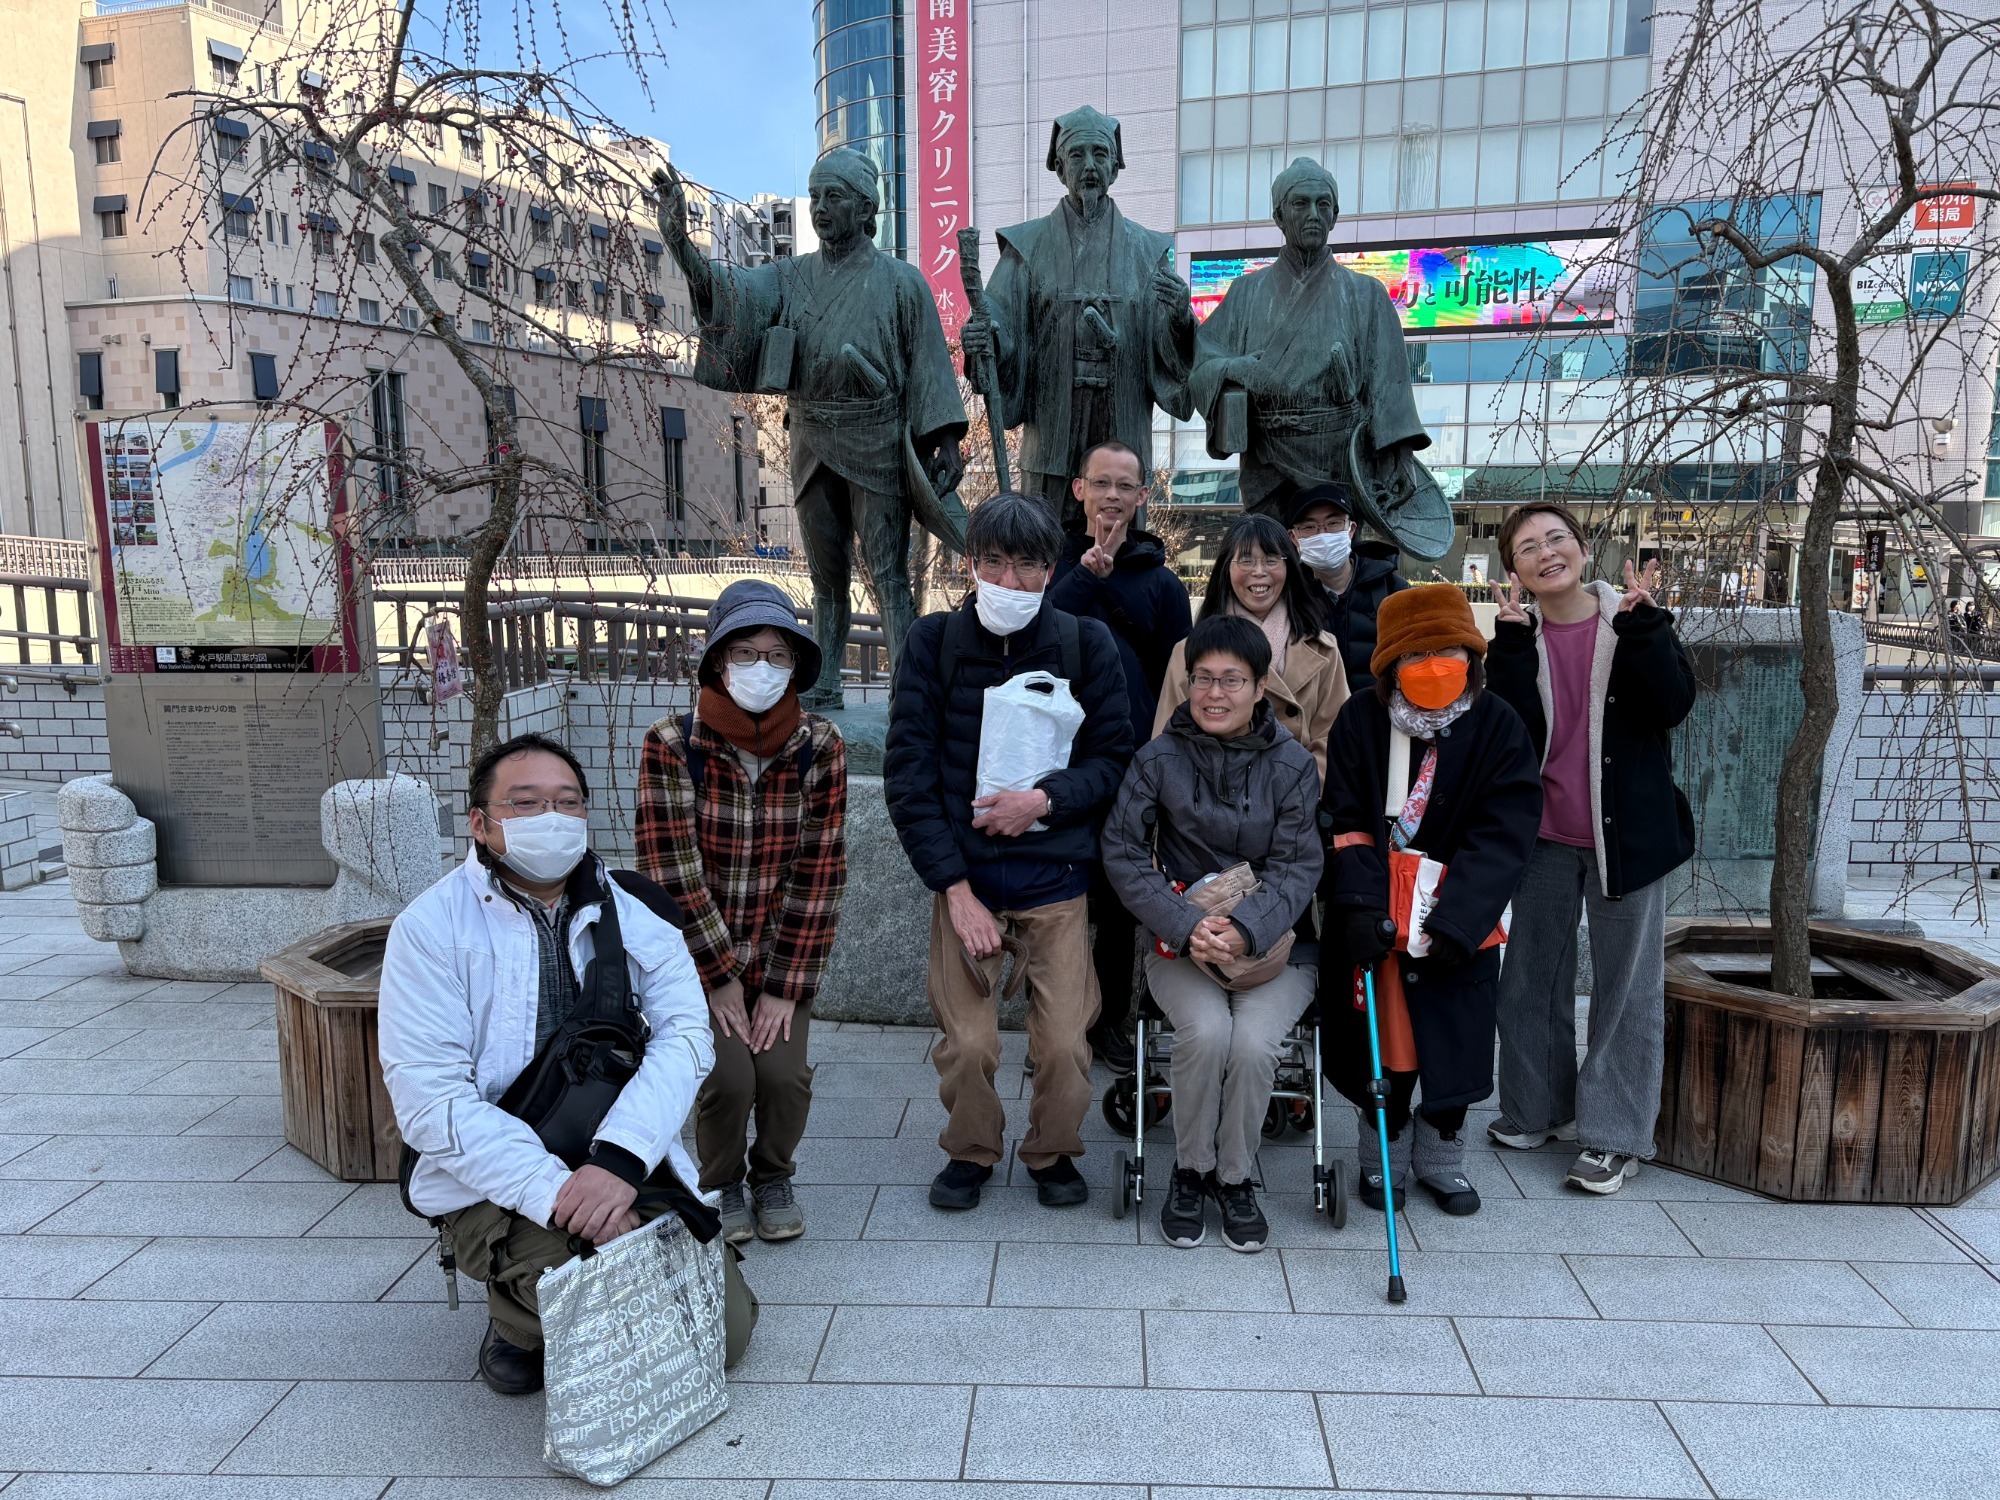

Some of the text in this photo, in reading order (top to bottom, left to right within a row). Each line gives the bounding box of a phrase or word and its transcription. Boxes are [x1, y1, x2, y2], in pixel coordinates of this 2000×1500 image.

[928, 0, 958, 277] 南美容クリニック
[1928, 207, 1960, 223] 薬局
[1915, 279, 1961, 294] NOVA
[198, 653, 268, 663] 水戸駅周辺案内図
[163, 704, 237, 714] 黄門さまゆかりの地
[623, 1297, 688, 1349] LARSON
[644, 1331, 682, 1364] LISA
[609, 1361, 712, 1437] LISA LARSON
